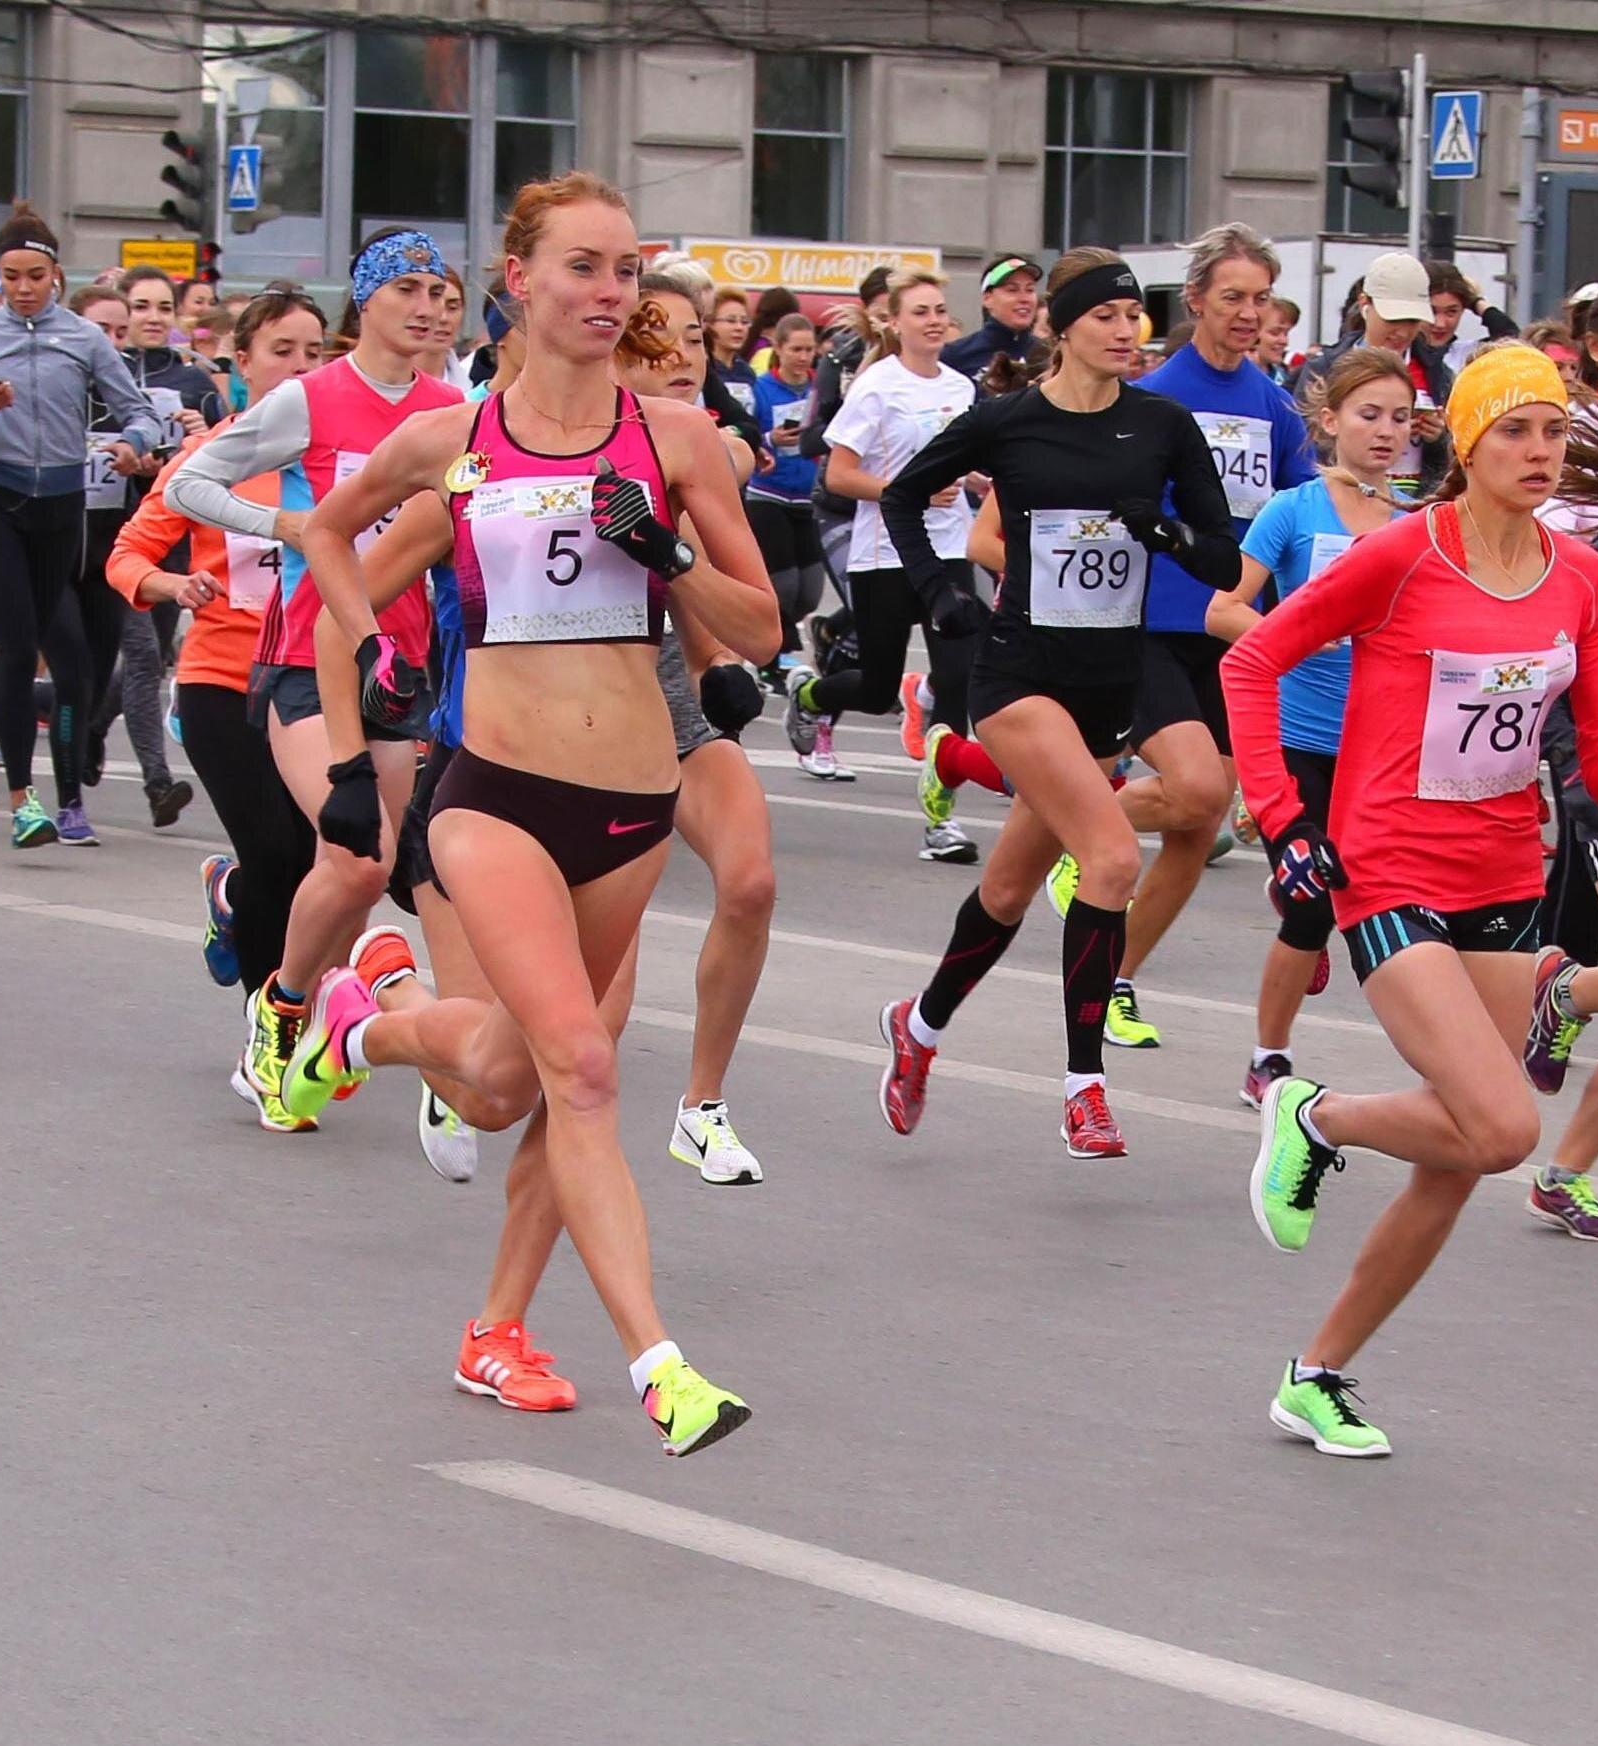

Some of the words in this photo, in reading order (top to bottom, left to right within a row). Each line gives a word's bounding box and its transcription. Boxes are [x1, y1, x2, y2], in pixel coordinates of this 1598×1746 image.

[258, 547, 283, 575] 4
[546, 530, 583, 587] 5
[1052, 549, 1131, 590] 789
[1458, 701, 1542, 754] 787
